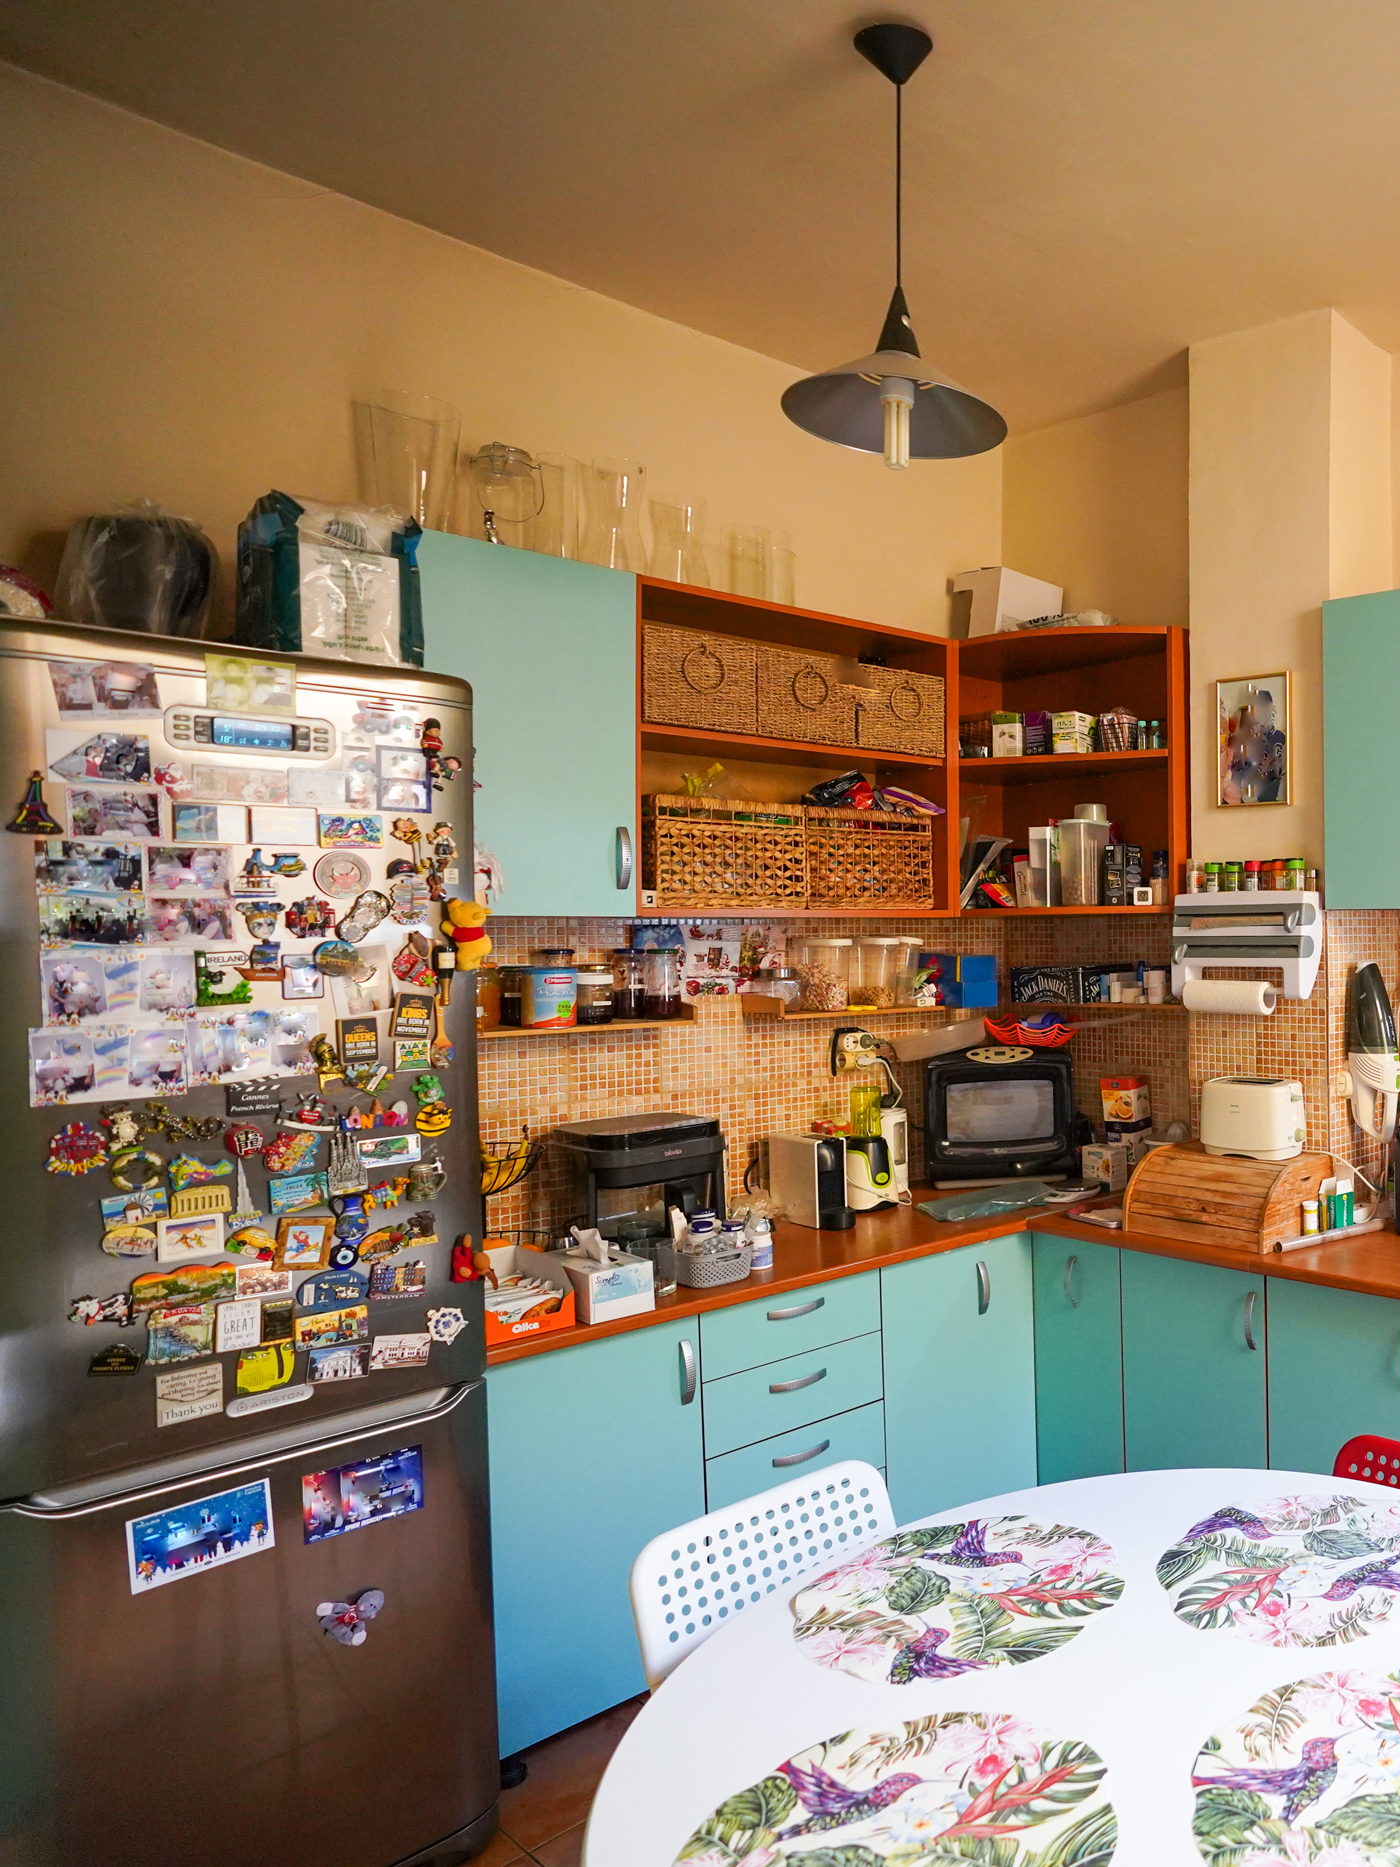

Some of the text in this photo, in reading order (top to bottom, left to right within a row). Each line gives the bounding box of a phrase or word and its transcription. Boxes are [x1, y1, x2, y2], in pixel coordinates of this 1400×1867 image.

[207, 955, 247, 963] IRELAND
[1021, 982, 1039, 1002] JACK
[1037, 974, 1068, 998] DANIEL'S
[401, 1007, 428, 1019] KINGS
[396, 1025, 427, 1034] NOVEMBER
[345, 1031, 376, 1043] QUEENS
[345, 1048, 376, 1056] SEPTEMBER
[230, 1102, 279, 1112] French Riviera
[340, 1110, 410, 1131] LONDON
[49, 1153, 106, 1173] LONDON
[232, 1218, 260, 1229] Dubai
[413, 1236, 436, 1246] SALZBURG
[239, 1301, 258, 1309] THINGS
[165, 1306, 201, 1319] CROATIA
[223, 1316, 257, 1334] GREAT
[160, 1376, 170, 1384] For
[170, 1372, 197, 1382] listening
[205, 1380, 221, 1389] always
[250, 1390, 305, 1409] ARISTON
[164, 1402, 219, 1420] Thank you
